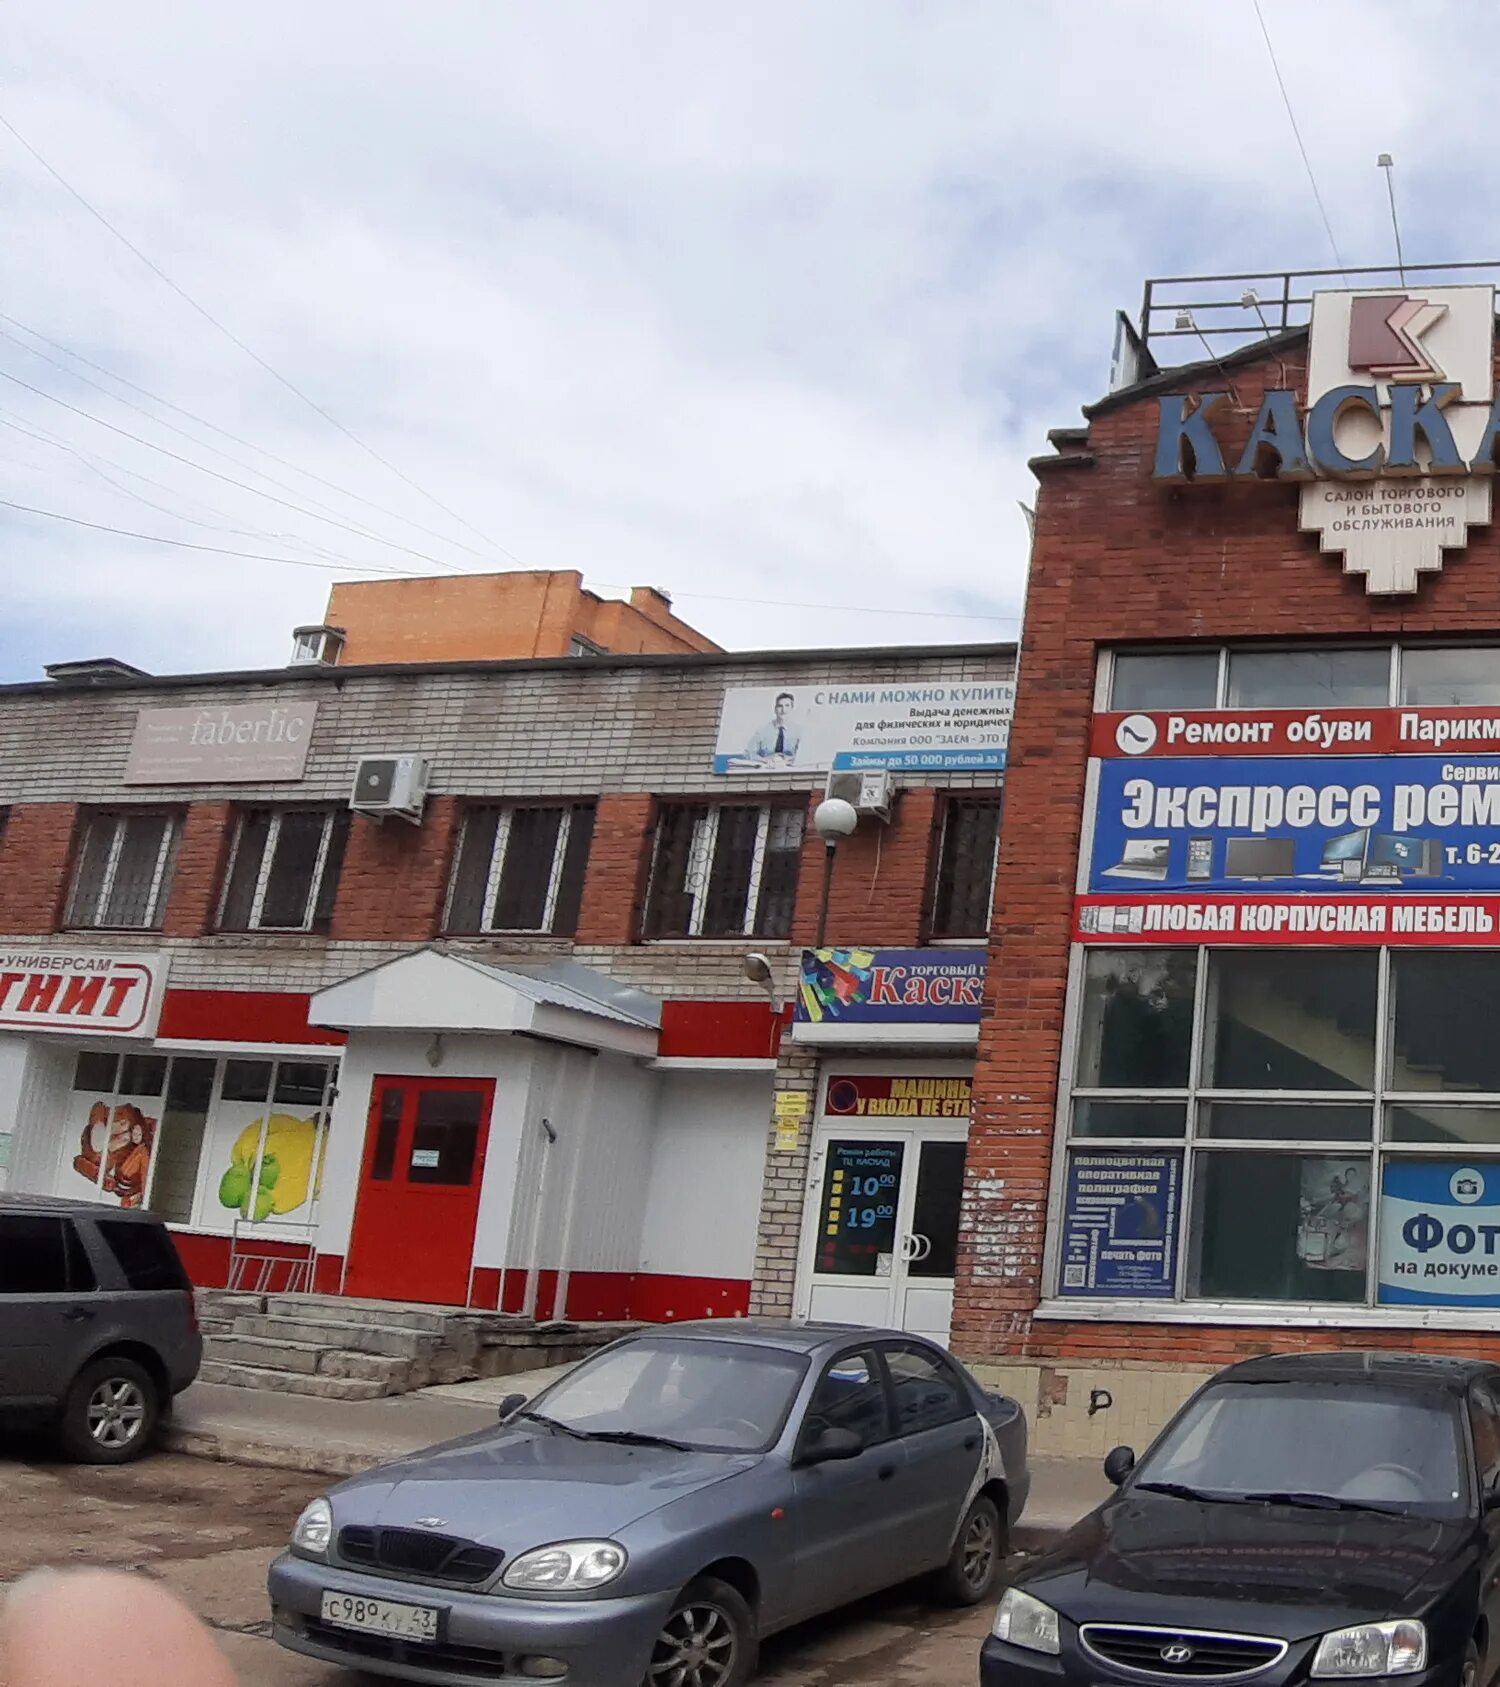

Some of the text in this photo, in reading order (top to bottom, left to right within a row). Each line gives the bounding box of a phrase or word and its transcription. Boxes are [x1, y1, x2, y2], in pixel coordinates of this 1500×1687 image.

[1324, 487, 1465, 502] САЛОН ТОРГОВОГО
[1346, 502, 1442, 516] И БЫТОВОГО
[1332, 517, 1455, 531] ОБСЛУЖИВАНИЯ
[814, 687, 1013, 705] С НАМИ МОЖНО КУПИТЬ
[910, 707, 1010, 717] Выдача денежных
[189, 708, 304, 745] faberlic
[855, 722, 874, 731] для
[878, 718, 941, 732] физических
[1167, 717, 1273, 743] Ремонт
[1287, 714, 1371, 748] обуви
[853, 737, 906, 746] Компания
[910, 735, 932, 745] ООО
[979, 734, 999, 743] ЭТО
[851, 756, 885, 766] Займы
[887, 757, 902, 767] до
[904, 755, 919, 765] 50
[921, 754, 942, 765] 000
[944, 753, 983, 766] рублей
[1121, 779, 1381, 832] Экспресс
[1446, 846, 1462, 864] т.
[1143, 904, 1235, 931] ЛЮБАЯ
[1240, 904, 1386, 932] КОРПУСНАЯ
[1392, 905, 1493, 932] МЕБЕЛЬ
[5, 955, 112, 971] УНИВЕРСАМ
[867, 966, 984, 1006] Каск
[856, 1099, 867, 1115] У
[868, 1099, 918, 1116] ВХОДА
[921, 1099, 941, 1116] НЕ
[843, 1158, 890, 1168] ТЦ КАСКАД
[1074, 1157, 1165, 1167] полноцветная
[1078, 1171, 1160, 1180] оперативная
[851, 1176, 879, 1196] 10
[1079, 1184, 1157, 1194] полиграфия
[847, 1207, 876, 1228] 19
[1394, 1262, 1417, 1275] на
